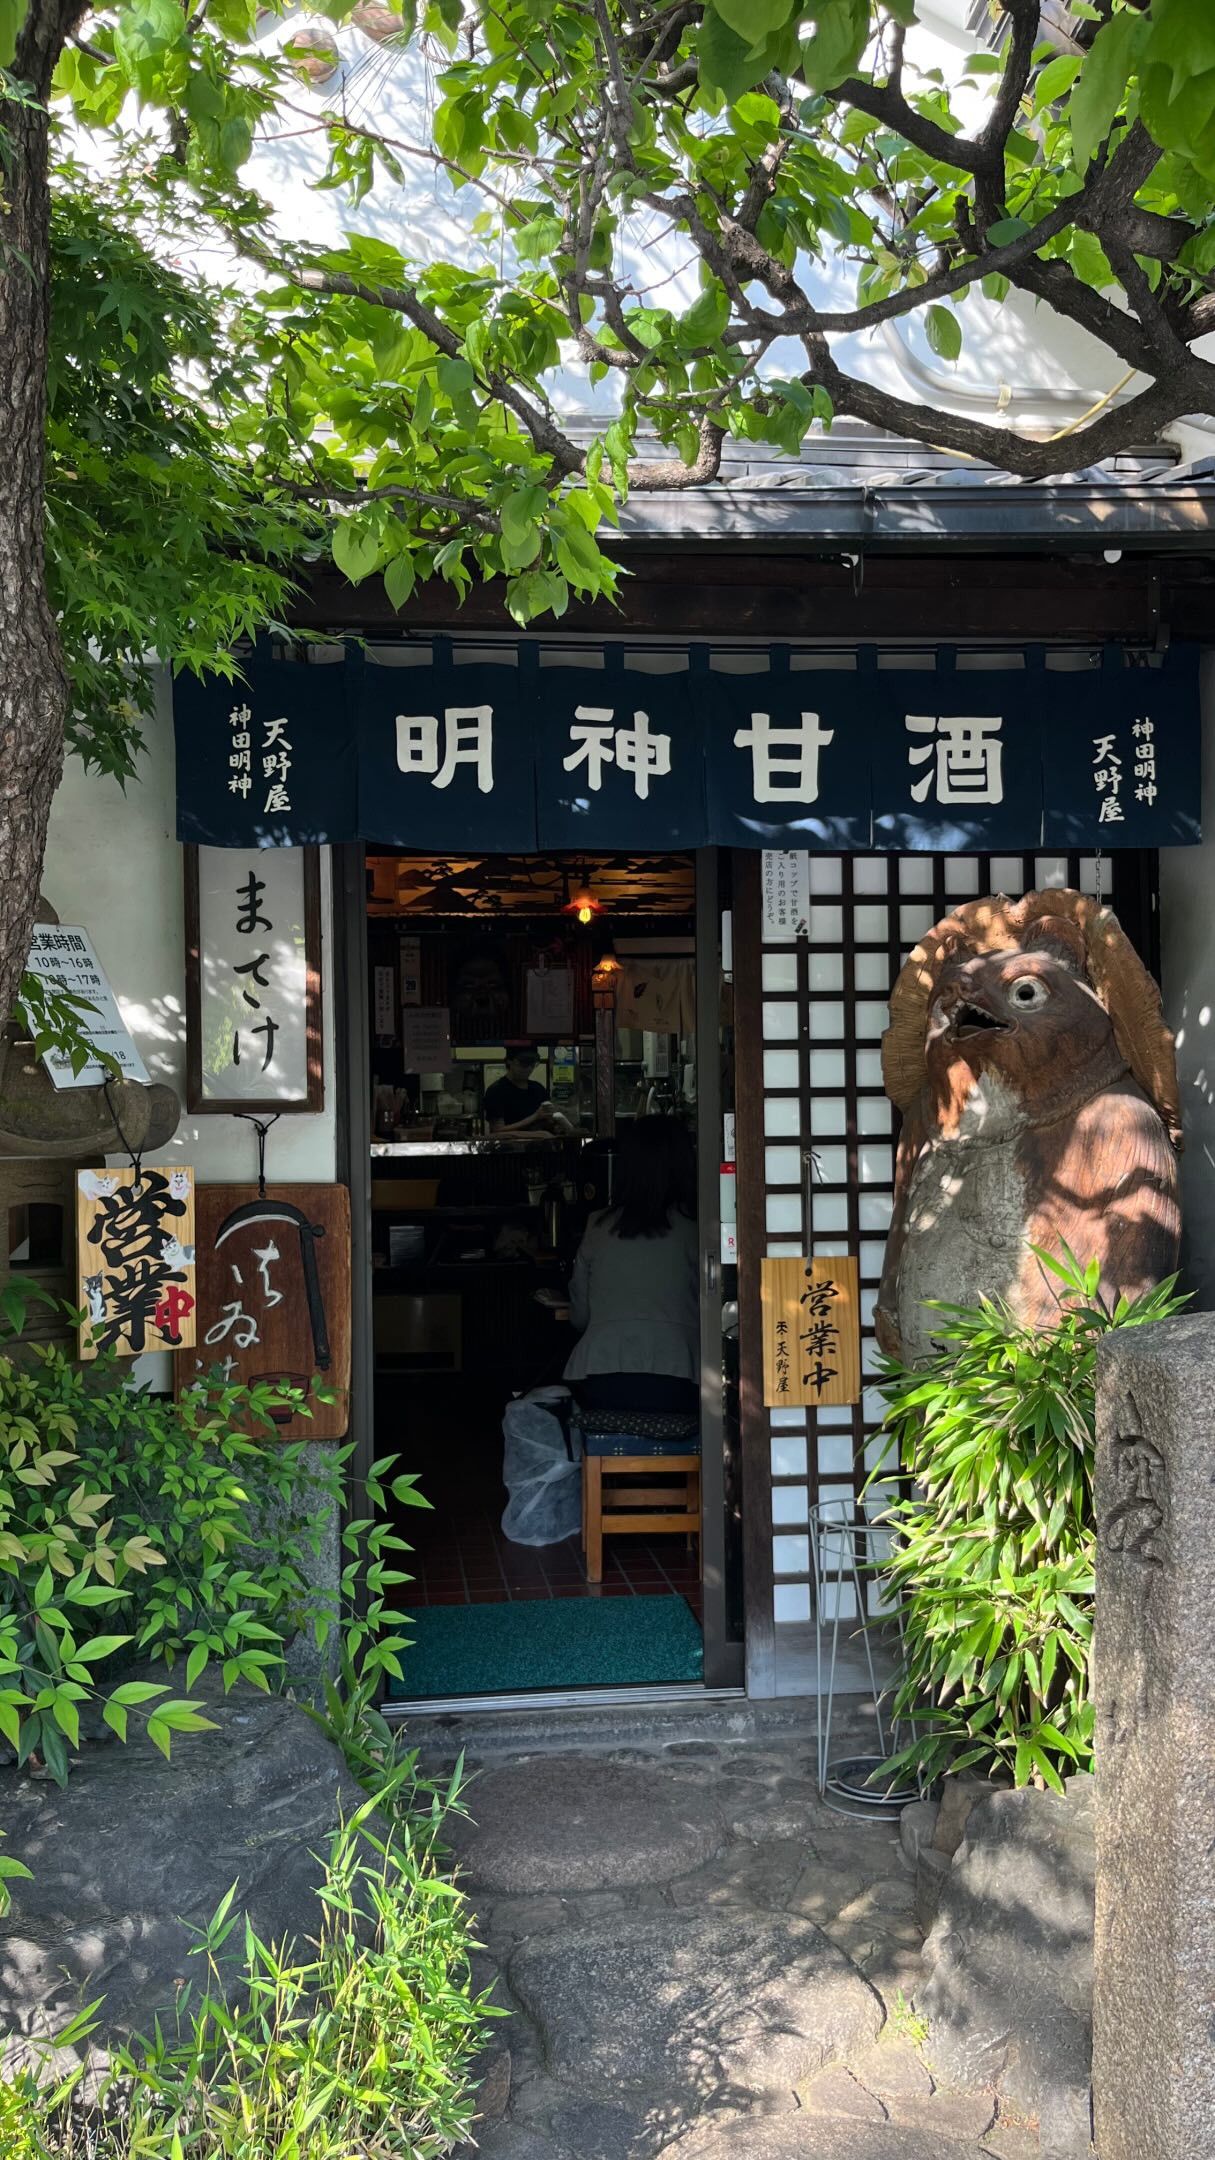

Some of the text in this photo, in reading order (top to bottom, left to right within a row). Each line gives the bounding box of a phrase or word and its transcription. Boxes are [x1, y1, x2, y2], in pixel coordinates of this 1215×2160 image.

[227, 703, 252, 799] 神田明神
[261, 717, 293, 813] 天野屋
[395, 704, 1004, 804] 明神甘酒
[1092, 734, 1125, 823] 天野屋
[1131, 716, 1158, 806] 神田明神
[233, 870, 280, 1072] まさけ
[800, 1279, 840, 1398] 営業中
